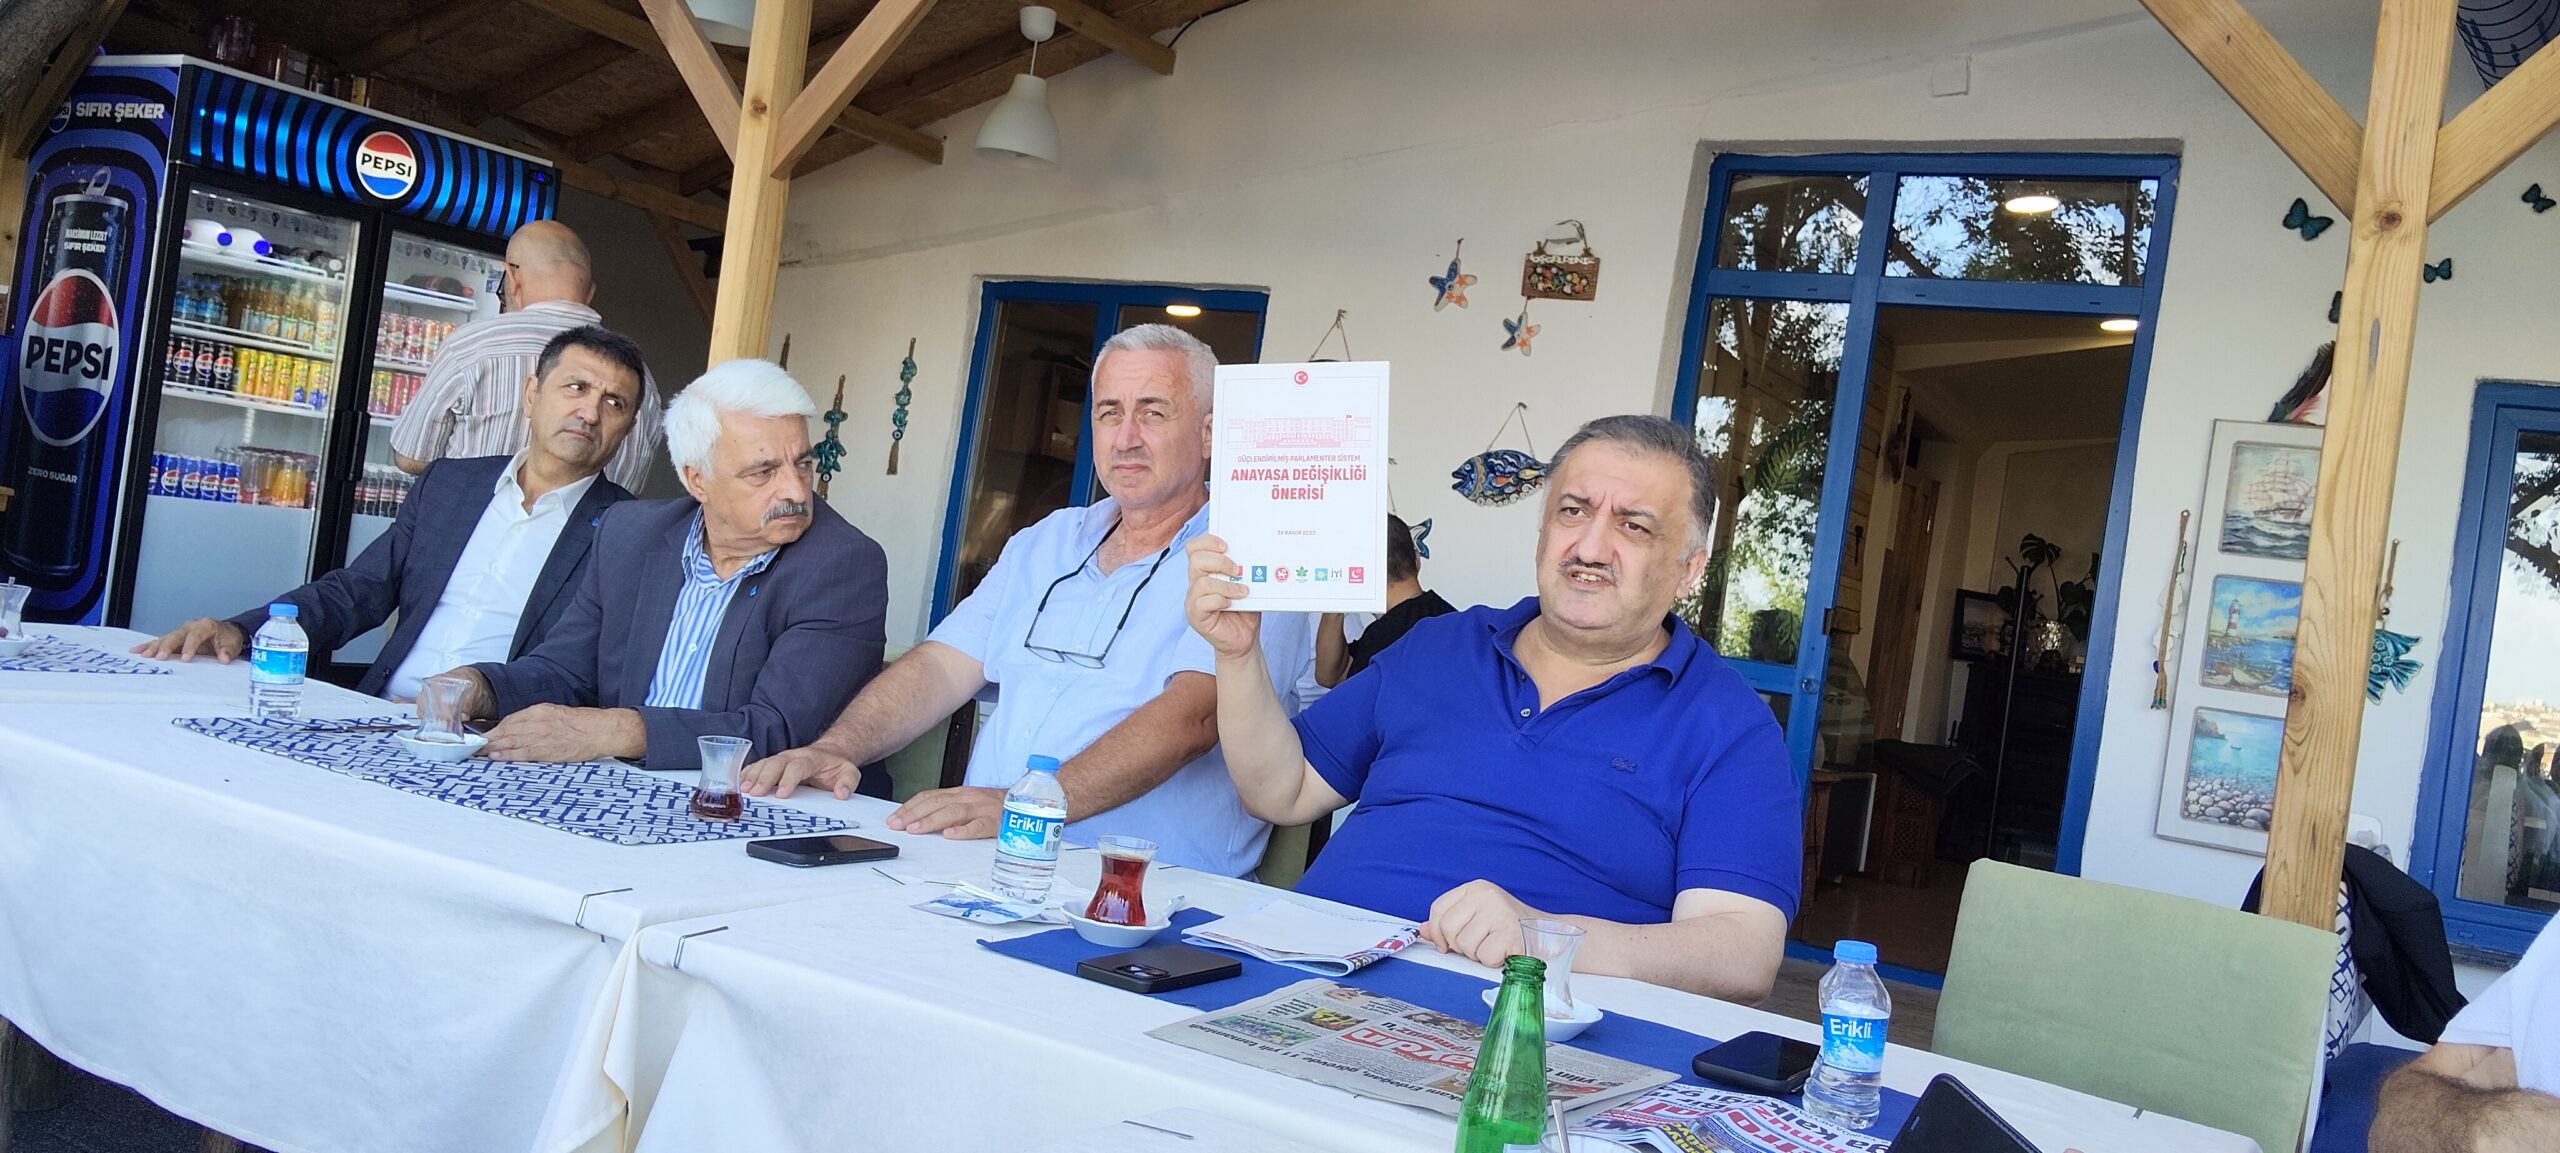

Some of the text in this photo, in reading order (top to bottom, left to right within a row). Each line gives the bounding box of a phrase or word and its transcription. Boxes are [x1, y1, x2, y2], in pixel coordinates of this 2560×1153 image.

[75, 102, 165, 123] SIFIR ŞEKER
[361, 153, 413, 177] PEPSI
[25, 335, 113, 381] PEPSI
[1237, 453, 1361, 463] GÜÇLENDİRİLMİŞ PARLAMENTER SİSTEM
[28, 466, 78, 484] ZERO SUGAR
[1231, 465, 1367, 485] ANAYASA DEĞİŞİKLİĞİ
[1271, 484, 1325, 500] ÖNERİSİ
[1009, 813, 1044, 833] Erikli
[1830, 1018, 1872, 1039] Erikli
